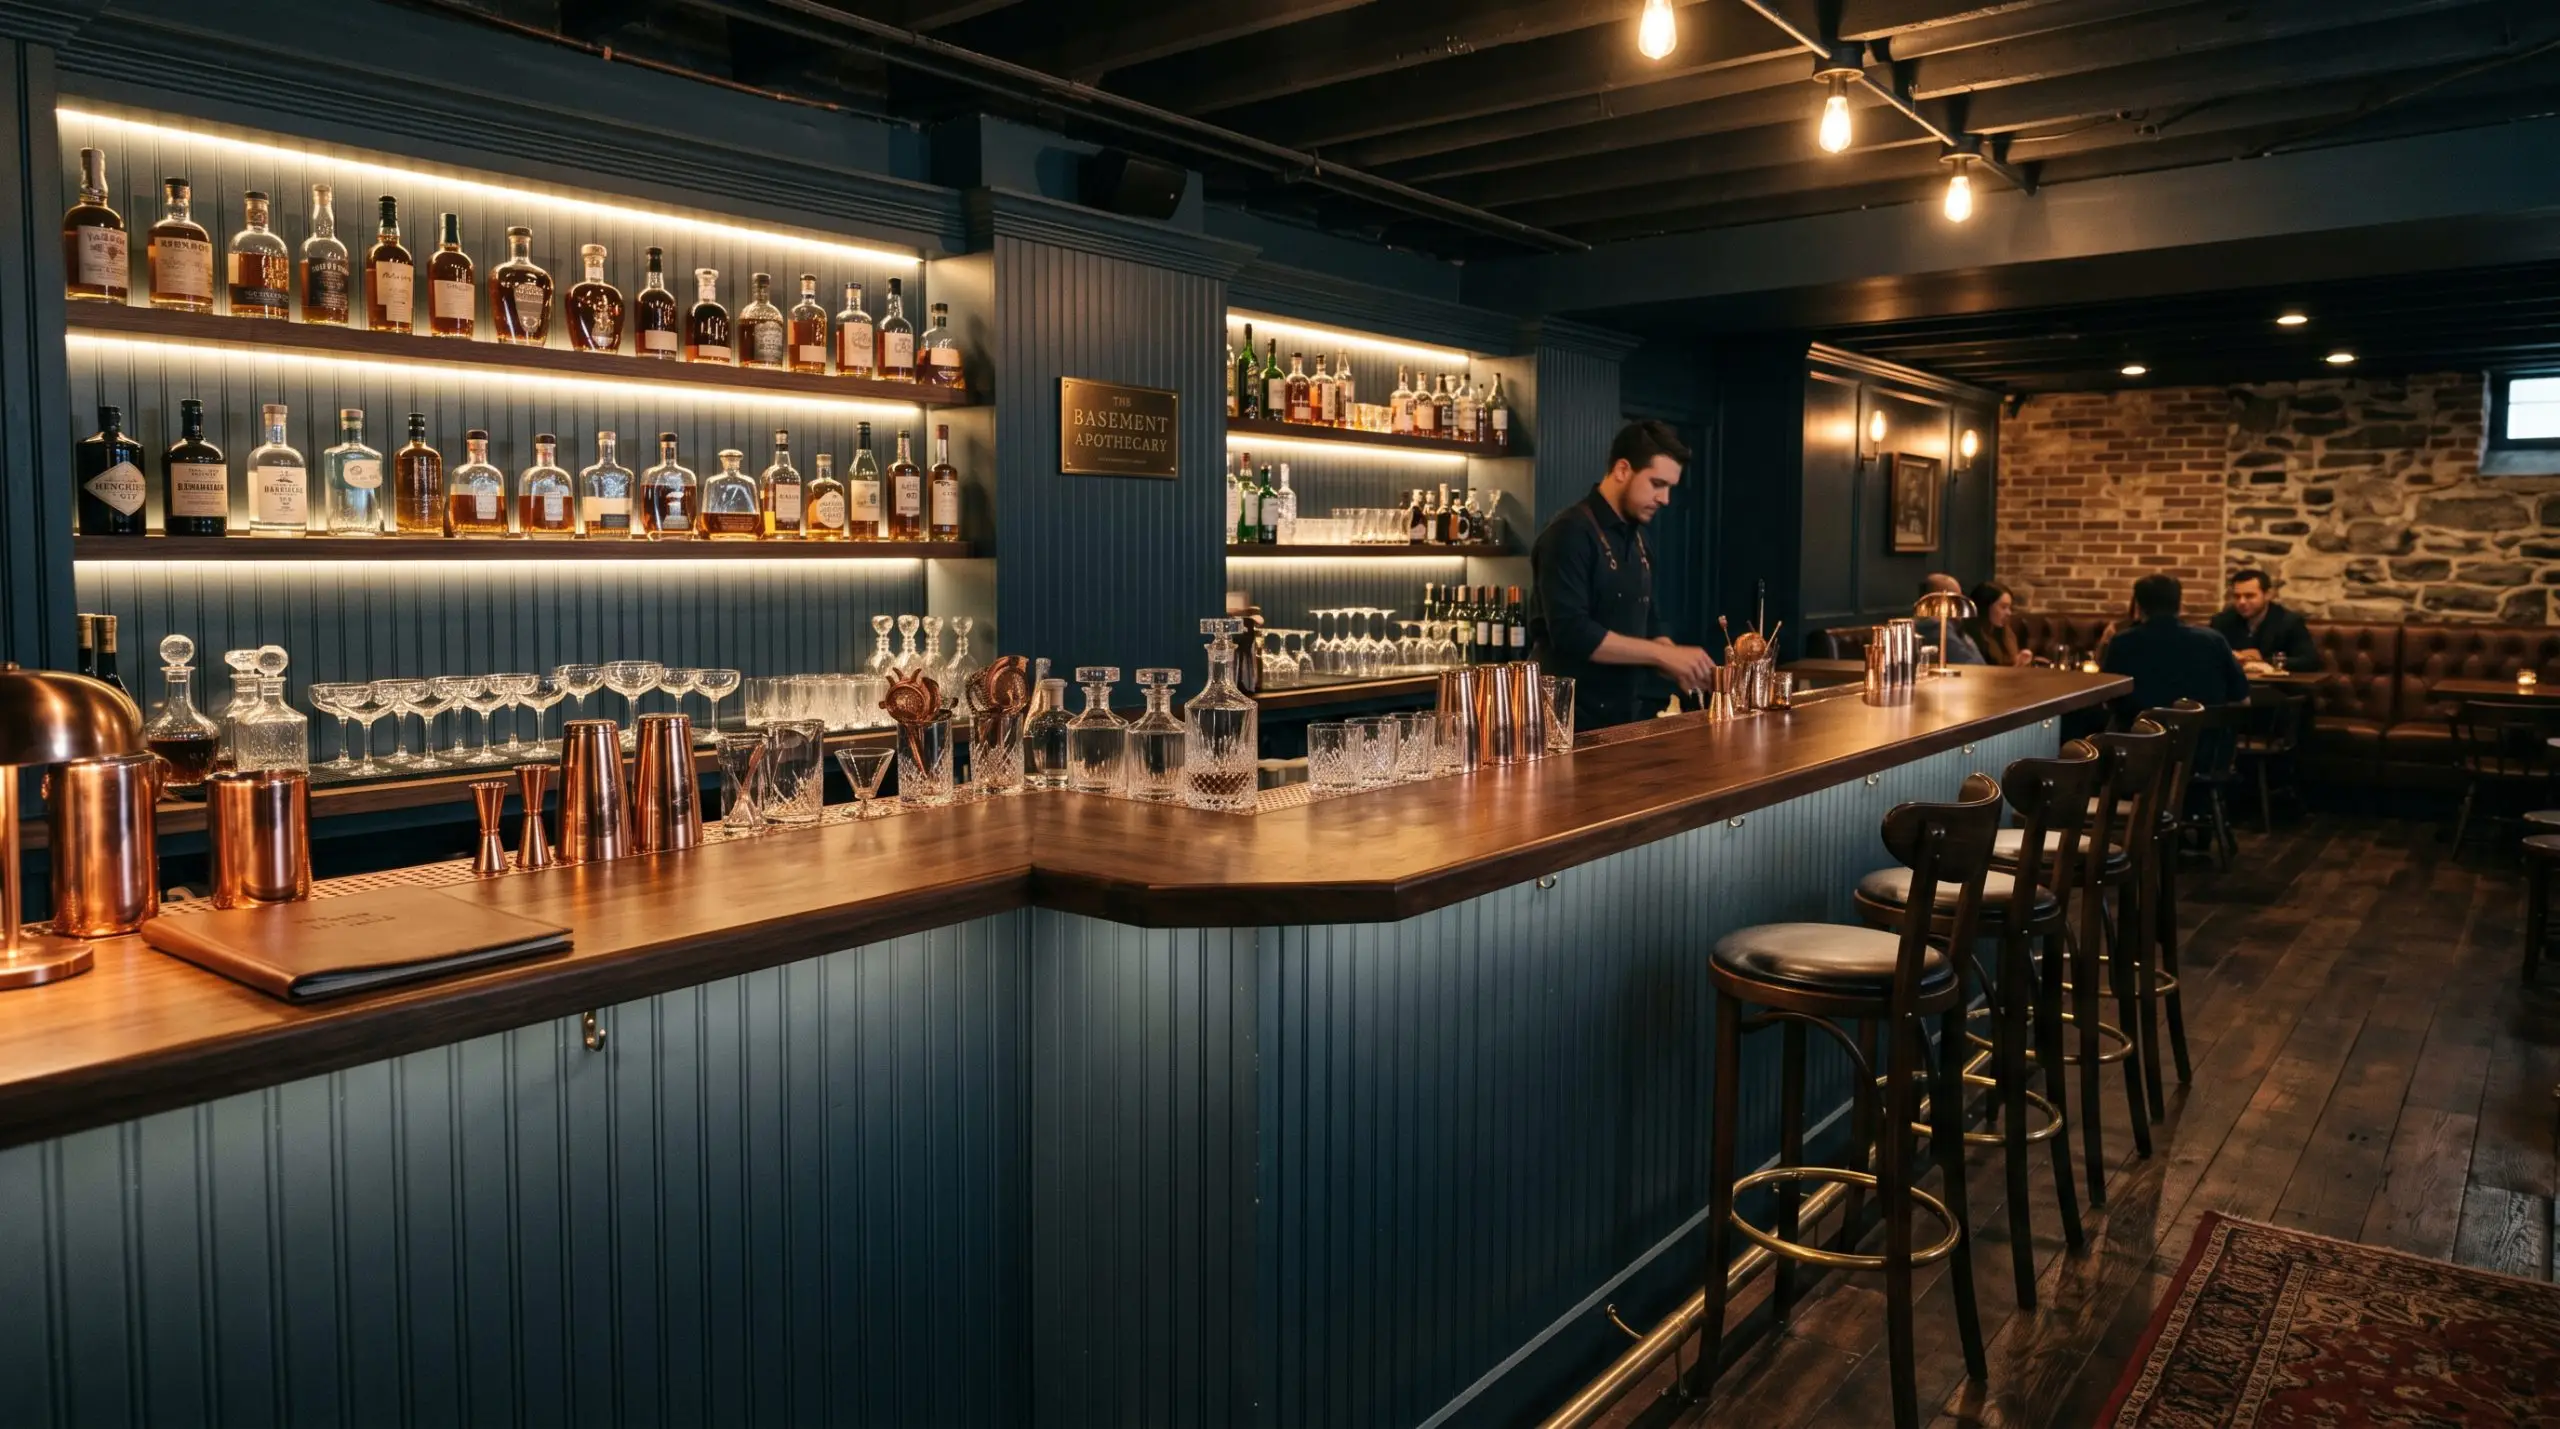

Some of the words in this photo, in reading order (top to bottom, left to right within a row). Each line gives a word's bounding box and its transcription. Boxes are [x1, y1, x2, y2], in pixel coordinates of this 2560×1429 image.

[1113, 396, 1132, 407] THE
[1074, 408, 1168, 433] BASEMENT
[1074, 433, 1167, 452] APOTHECARY
